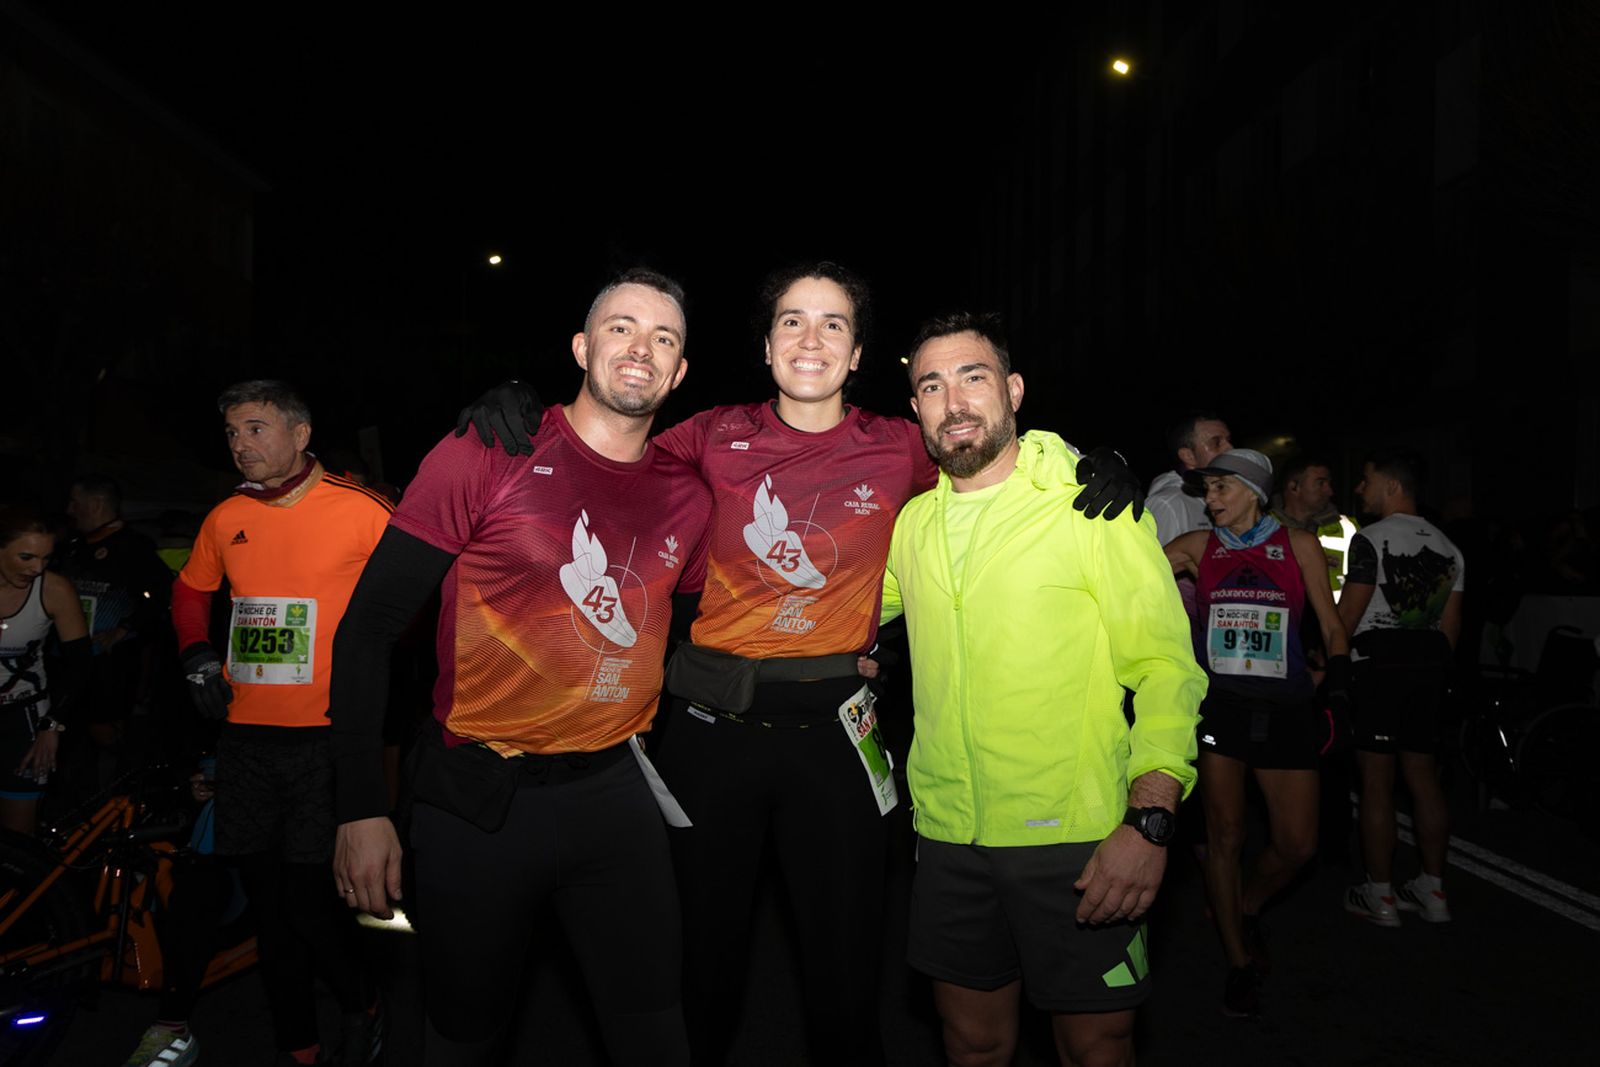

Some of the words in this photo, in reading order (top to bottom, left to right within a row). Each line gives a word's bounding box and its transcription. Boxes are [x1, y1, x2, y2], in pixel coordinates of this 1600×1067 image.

[766, 540, 802, 573] 43
[1209, 588, 1255, 599] endurance
[265, 607, 278, 615] DE
[582, 586, 617, 624] 43
[779, 606, 803, 617] SAN
[1217, 620, 1233, 628] SAN
[240, 628, 295, 654] 9253
[596, 672, 620, 685] SAN
